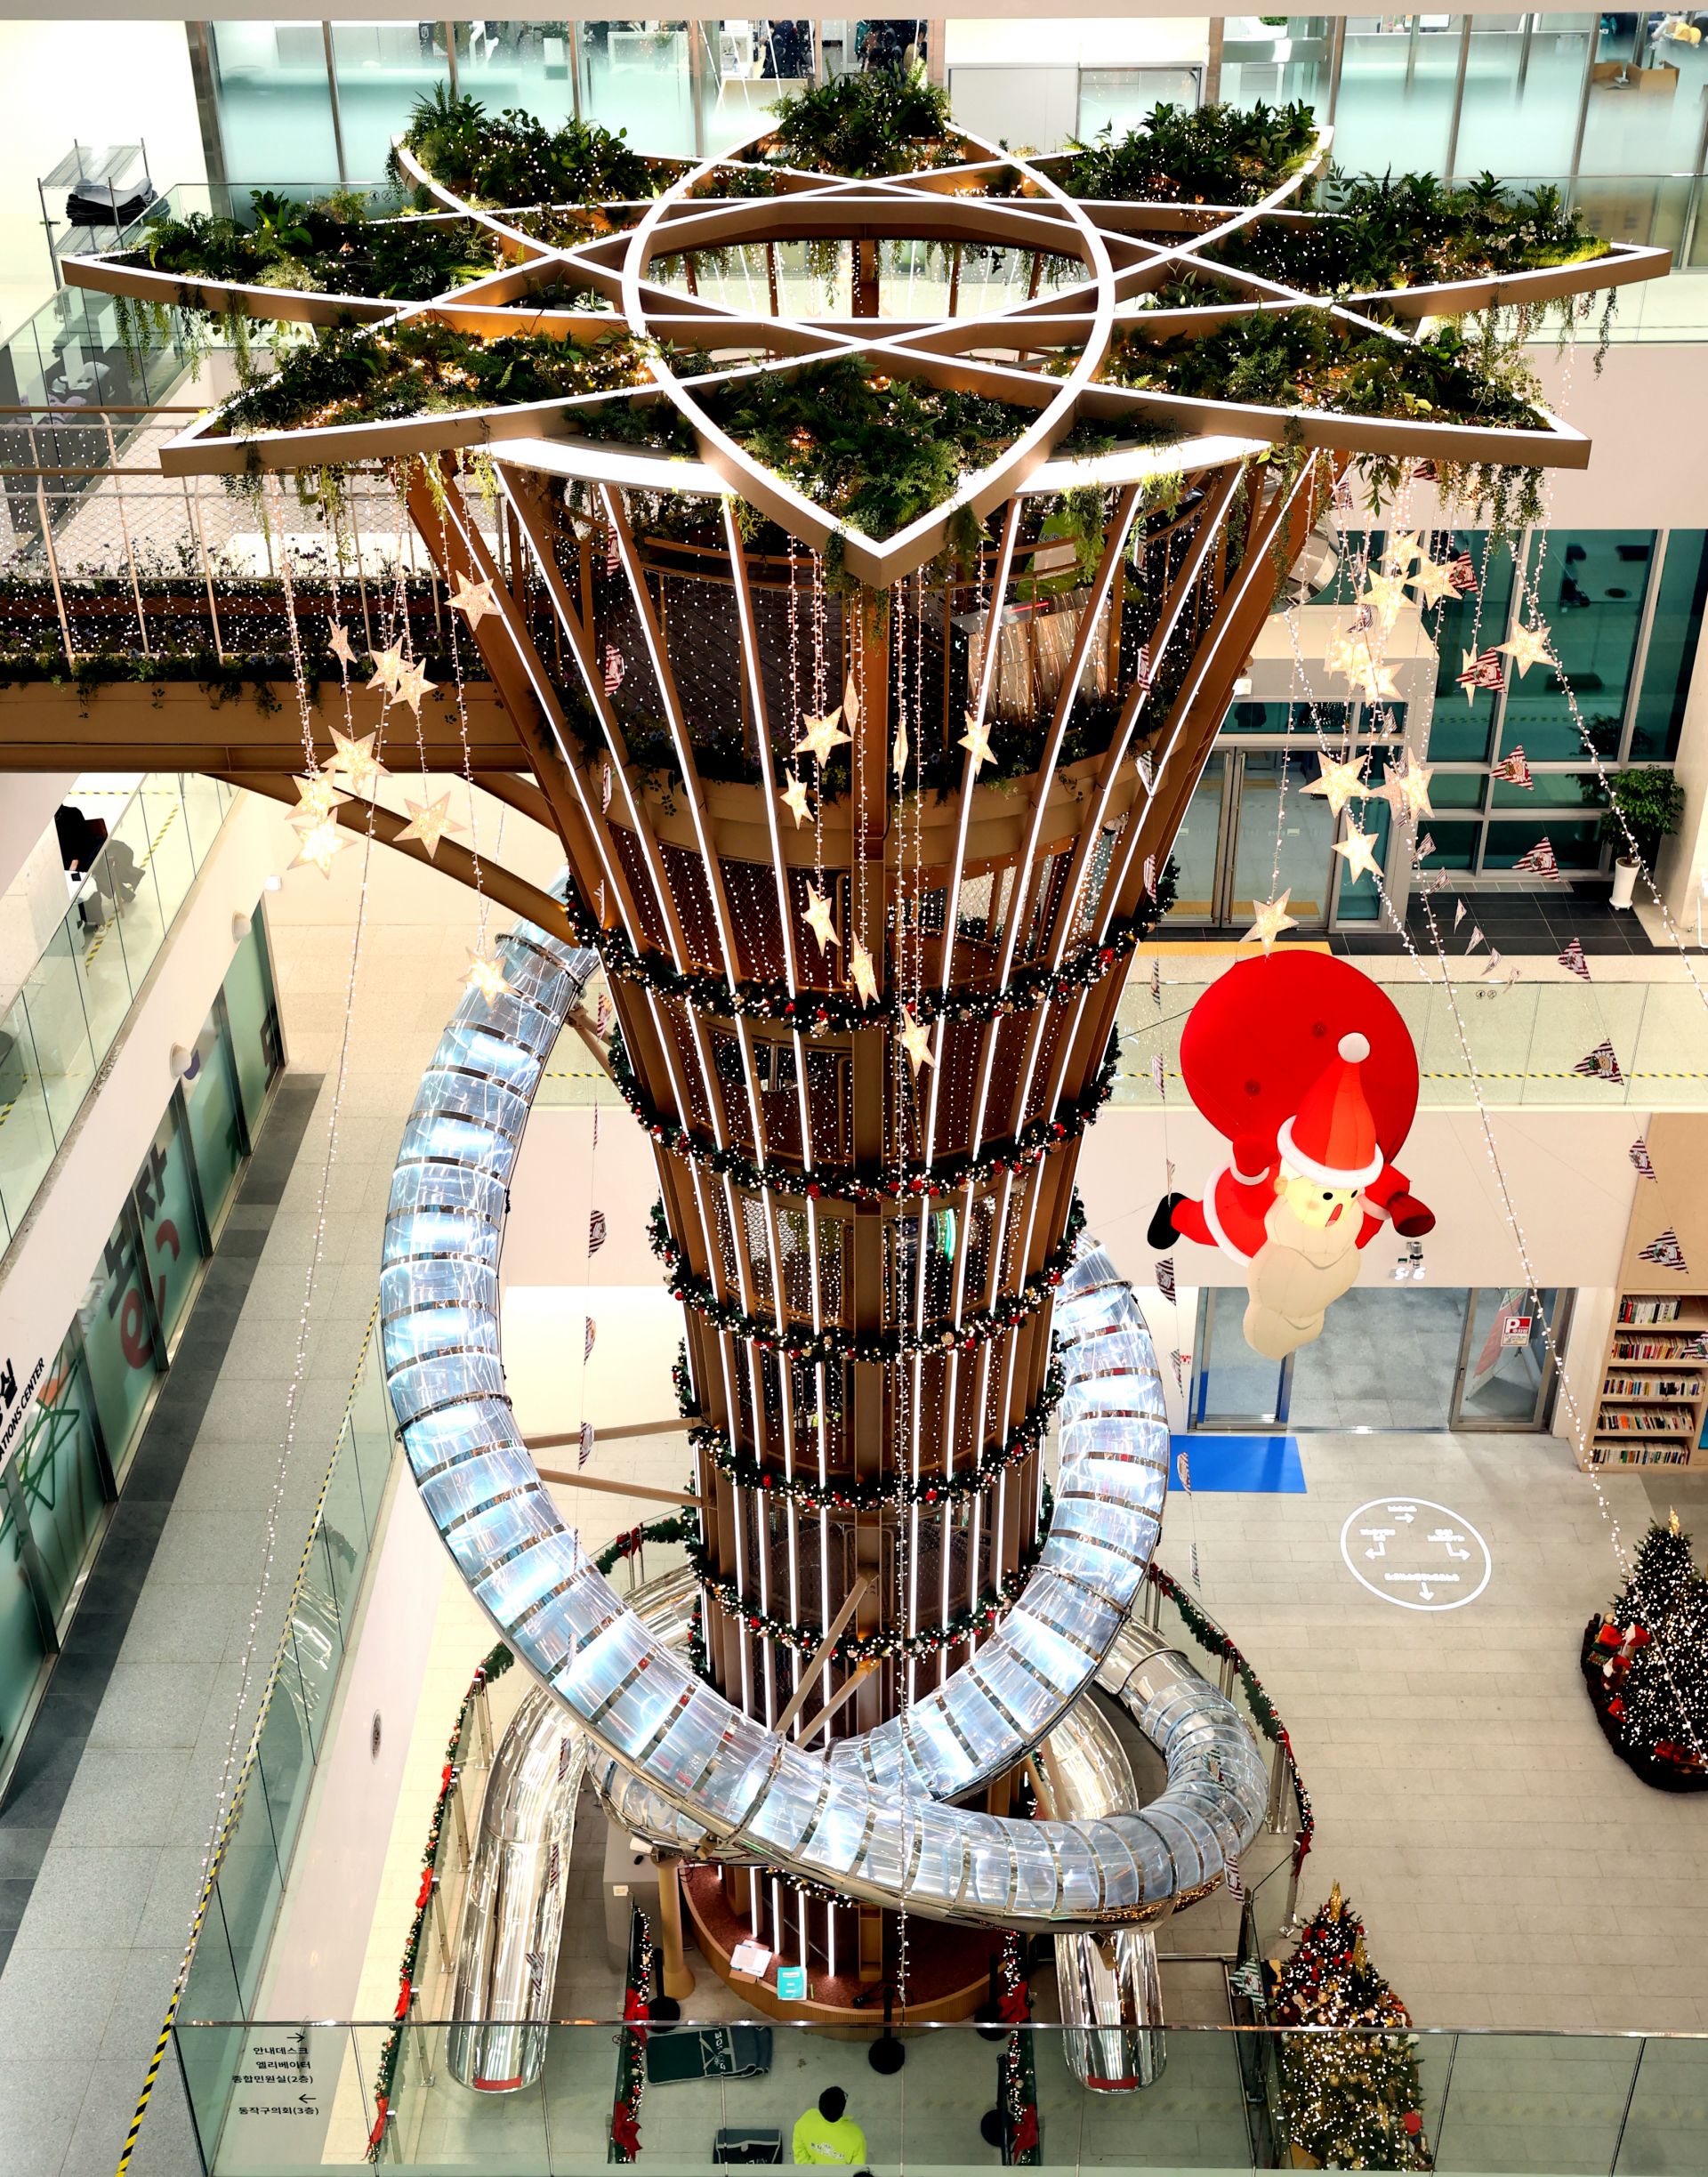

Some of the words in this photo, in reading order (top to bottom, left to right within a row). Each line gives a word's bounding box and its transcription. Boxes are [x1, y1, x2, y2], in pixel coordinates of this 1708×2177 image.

[20, 1358, 44, 1408] CENTER
[253, 2047, 310, 2055] 안내데스크
[255, 2061, 311, 2069] 엘리베이터
[231, 2075, 313, 2084] 종합민원실(2층)
[238, 2106, 319, 2116] 동작구의회(3층)
